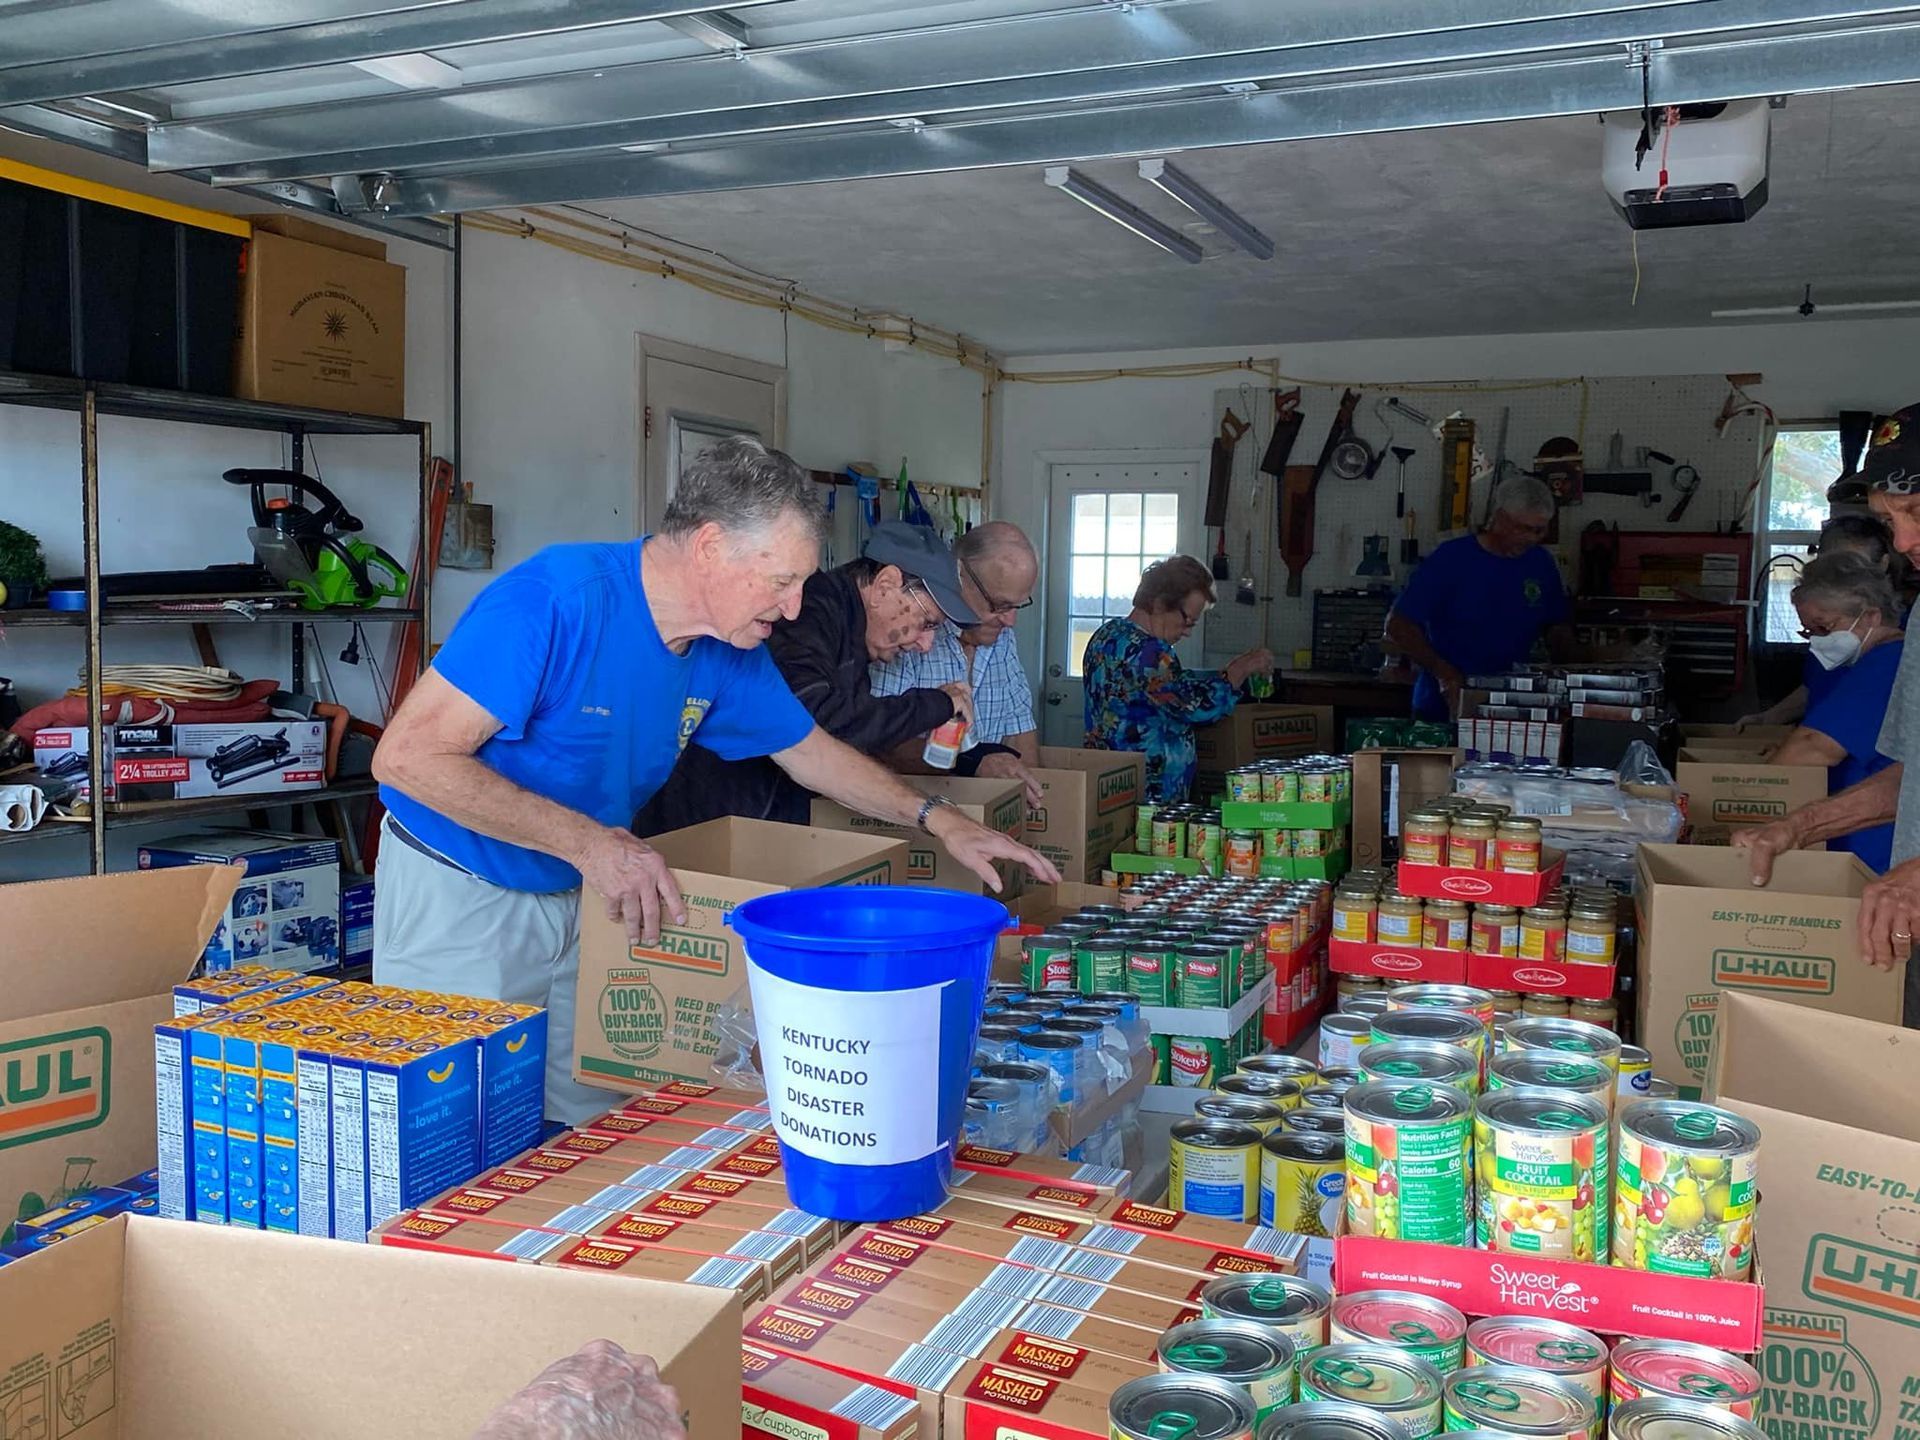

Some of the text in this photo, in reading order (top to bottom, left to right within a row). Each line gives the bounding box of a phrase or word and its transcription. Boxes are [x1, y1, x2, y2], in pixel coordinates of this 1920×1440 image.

[1257, 720, 1313, 735] U-HAUL
[142, 768, 186, 778] TROLLEY JACK
[1100, 771, 1135, 798] U-HAUL
[1718, 803, 1782, 816] U-HAUL
[691, 896, 736, 911] HANDLES
[1712, 910, 1842, 930] EASY-TO-LIFT HANDLES
[657, 936, 723, 961] -HAUL
[1720, 955, 1827, 979] U-HAUL
[610, 971, 648, 980] U-HAUL
[607, 988, 656, 1012] 100%
[675, 996, 704, 1011] NEED
[604, 1013, 663, 1029] BUY-BACK
[675, 1010, 701, 1025] TAKE
[674, 1024, 722, 1045] We'll Buy
[782, 1025, 871, 1055] KENTUCKY
[673, 1038, 691, 1051] the
[1171, 1048, 1208, 1069] Stokely's
[783, 1055, 869, 1086] TORNADO
[494, 1080, 512, 1095] love
[638, 1099, 678, 1110] MASHED
[787, 1086, 865, 1116] DISASTER
[415, 1113, 439, 1129] love
[604, 1117, 644, 1129] MASHED
[781, 1111, 877, 1147] DONATIONS
[1401, 1128, 1460, 1142] Nutrition Facts
[567, 1137, 610, 1149] MASHED
[1511, 1141, 1541, 1153] Sweet
[530, 1155, 574, 1168] MASHED
[963, 1149, 1010, 1163] MASHED
[1515, 1151, 1557, 1163] Harvest
[726, 1158, 772, 1171] MASHED
[1401, 1158, 1460, 1174] Calories 60
[1516, 1163, 1550, 1175] FRUIT
[490, 1174, 537, 1188] MASHED
[691, 1178, 740, 1192] MASHED
[1504, 1171, 1563, 1186] COCKTAIL
[448, 1195, 497, 1210] MASHED
[1039, 1189, 1087, 1204] MASHED
[655, 1199, 706, 1213] MASHED
[1122, 1206, 1174, 1225] MASHED
[1126, 1216, 1162, 1227] POTATOES
[401, 1217, 450, 1234] MASHED
[616, 1220, 669, 1235] MASHED
[619, 1228, 653, 1238] POTATOES
[1017, 1217, 1068, 1234] MASHED
[573, 1247, 626, 1262] MASHED
[860, 1241, 914, 1260] MASHED
[864, 1249, 900, 1262] POTATOES
[575, 1256, 609, 1266] POTATOES
[831, 1263, 887, 1285] MASHED
[834, 1273, 871, 1287] POTATOES
[1362, 1271, 1462, 1289] Fruit Cocktail in Heavy Syrup
[1490, 1263, 1562, 1292] Sweet
[798, 1287, 854, 1311] MASHED
[800, 1299, 838, 1313] POTATOES
[1499, 1284, 1590, 1313] Harvest
[1632, 1304, 1741, 1327] Fruit Cocktail in 100% Juice
[758, 1316, 817, 1341] MASHED
[760, 1328, 800, 1344] POTATOES
[1012, 1343, 1075, 1368] MASHED
[1441, 1347, 1459, 1358] Facts
[1017, 1357, 1060, 1372] POTATOES
[979, 1375, 1044, 1401] MASHED
[984, 1390, 1028, 1406] POTATOES
